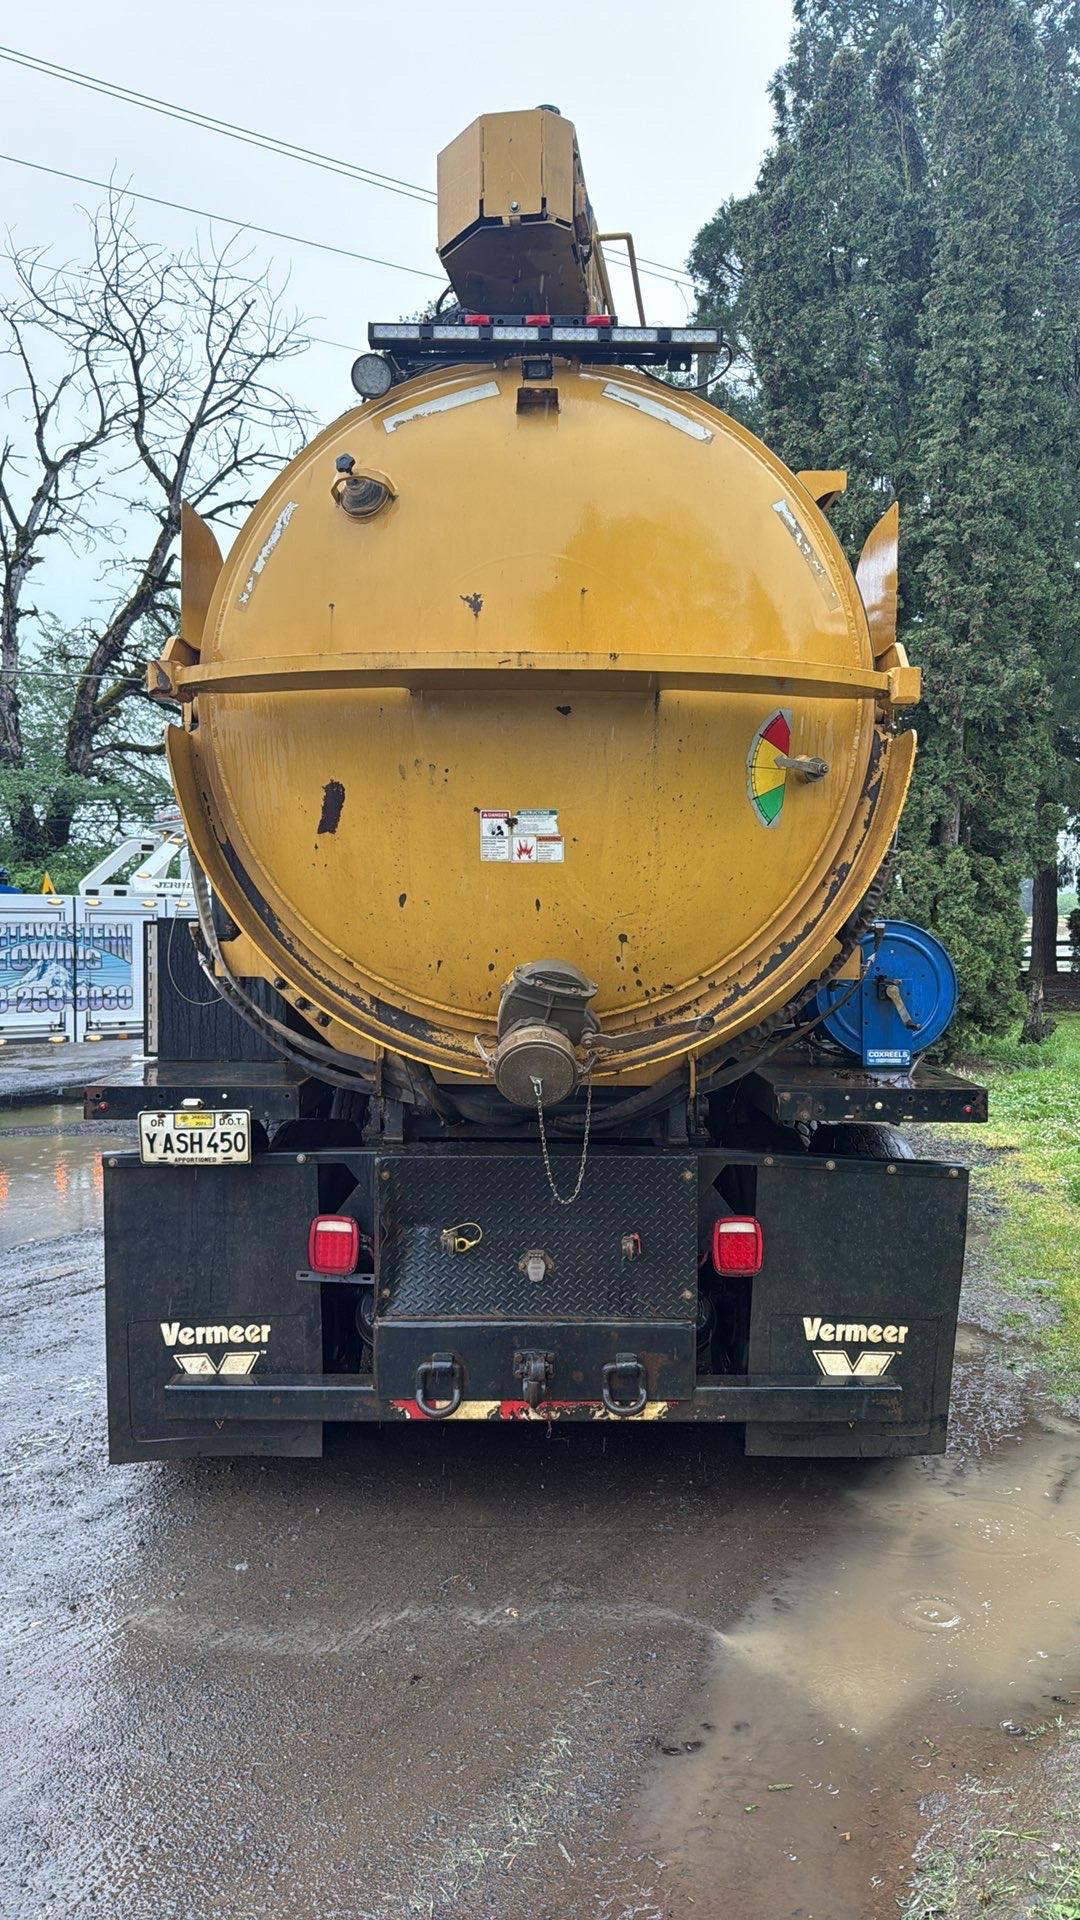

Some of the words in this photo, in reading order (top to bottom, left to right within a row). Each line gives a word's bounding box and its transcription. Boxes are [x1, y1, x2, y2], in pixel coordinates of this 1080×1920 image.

[150, 1119, 165, 1127] OR
[160, 1322, 271, 1346] Vermeer
[802, 1317, 909, 1344] Vermeer
